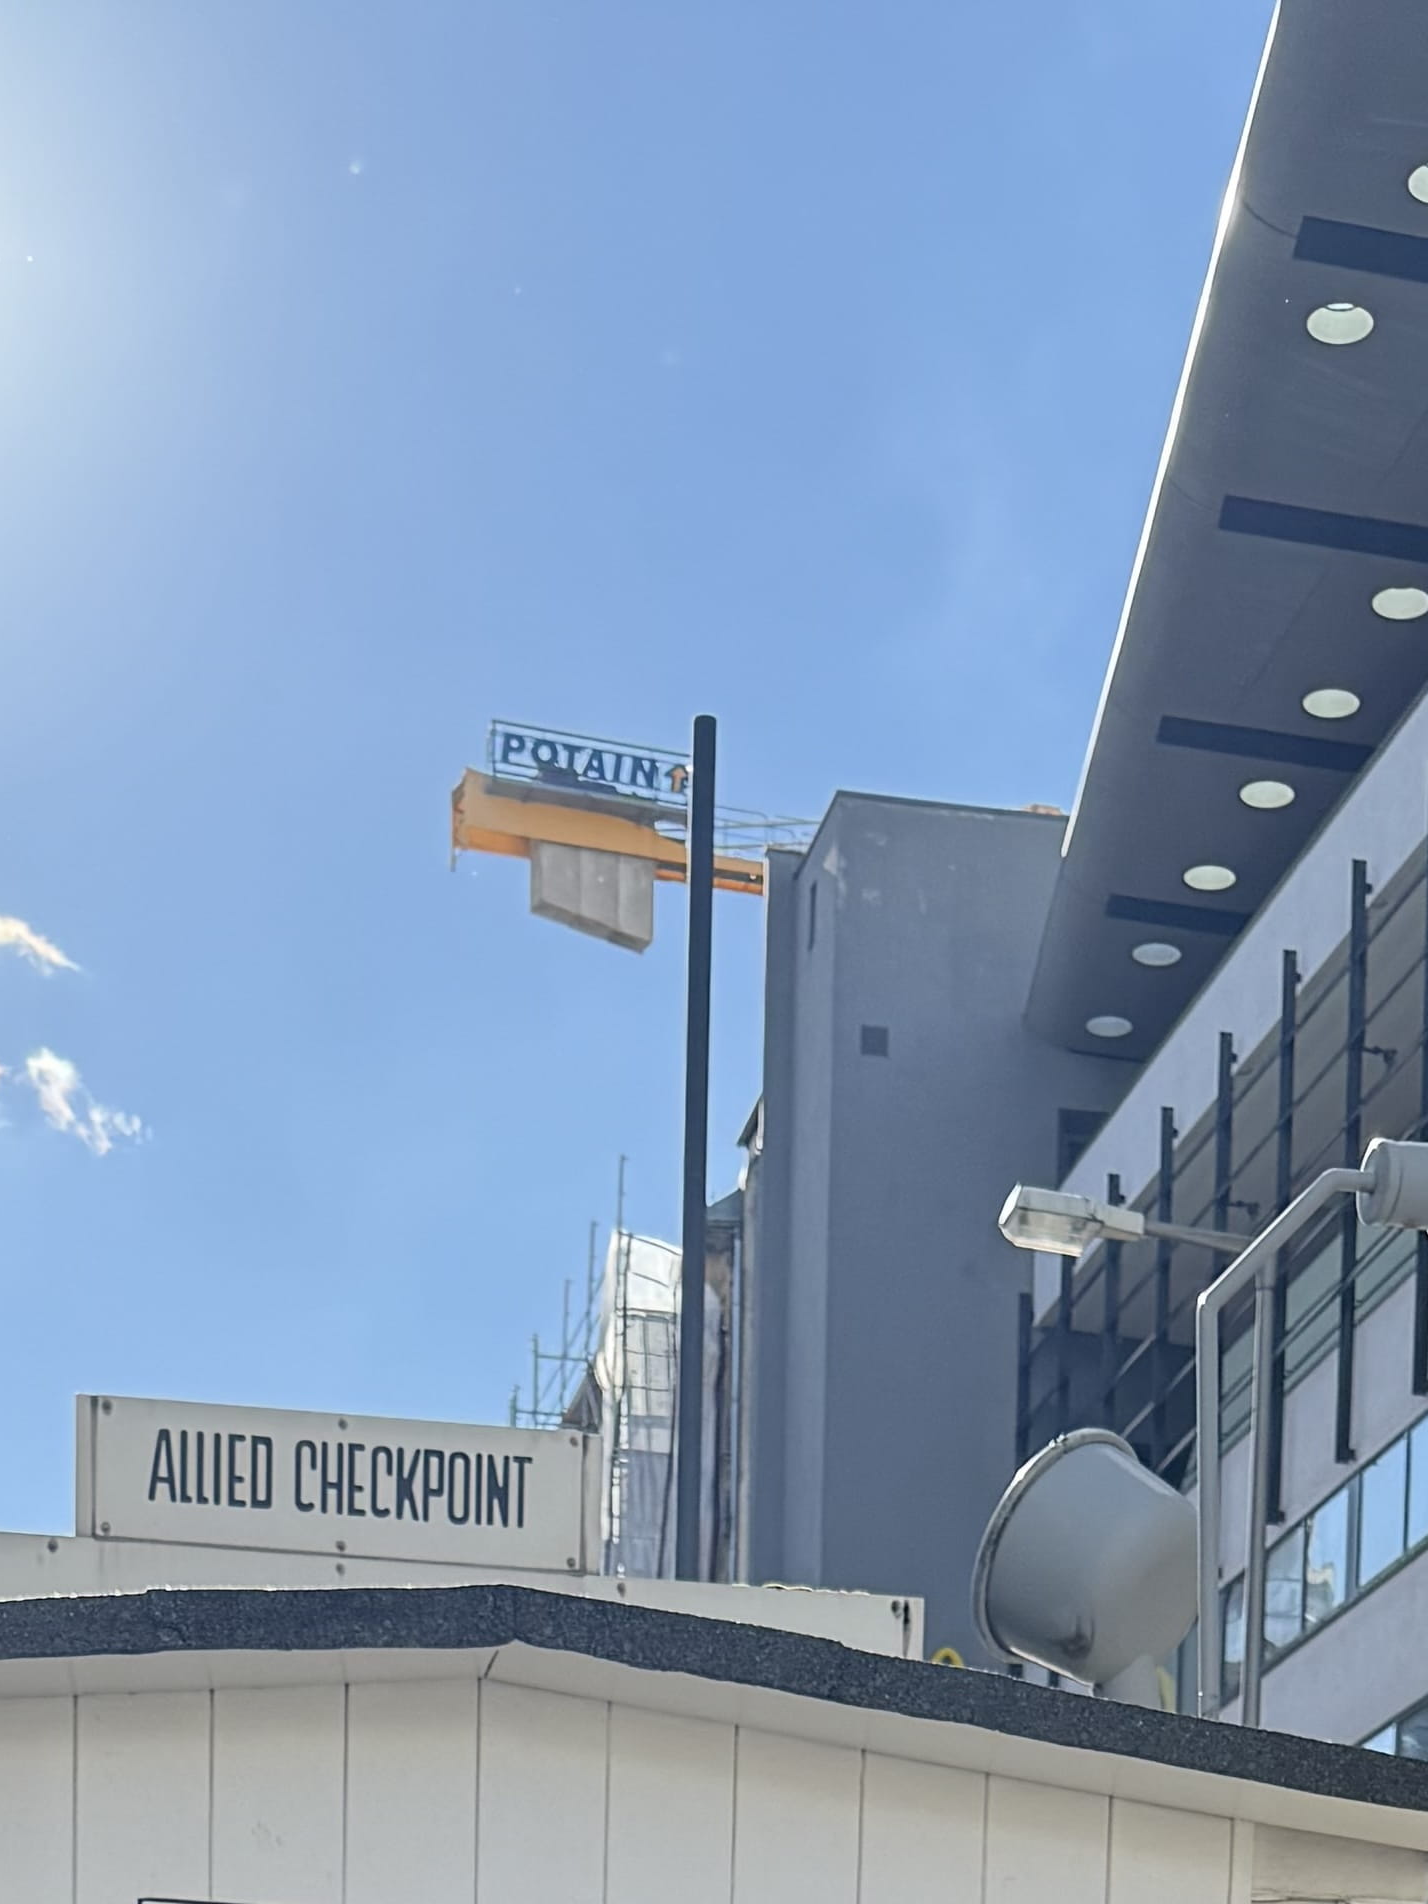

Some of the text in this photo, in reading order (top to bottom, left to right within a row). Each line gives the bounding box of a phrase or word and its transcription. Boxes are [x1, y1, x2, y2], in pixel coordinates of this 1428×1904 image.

[500, 732, 659, 789] POTAIN
[148, 1428, 534, 1529] ALLIED CHECKPOINT
